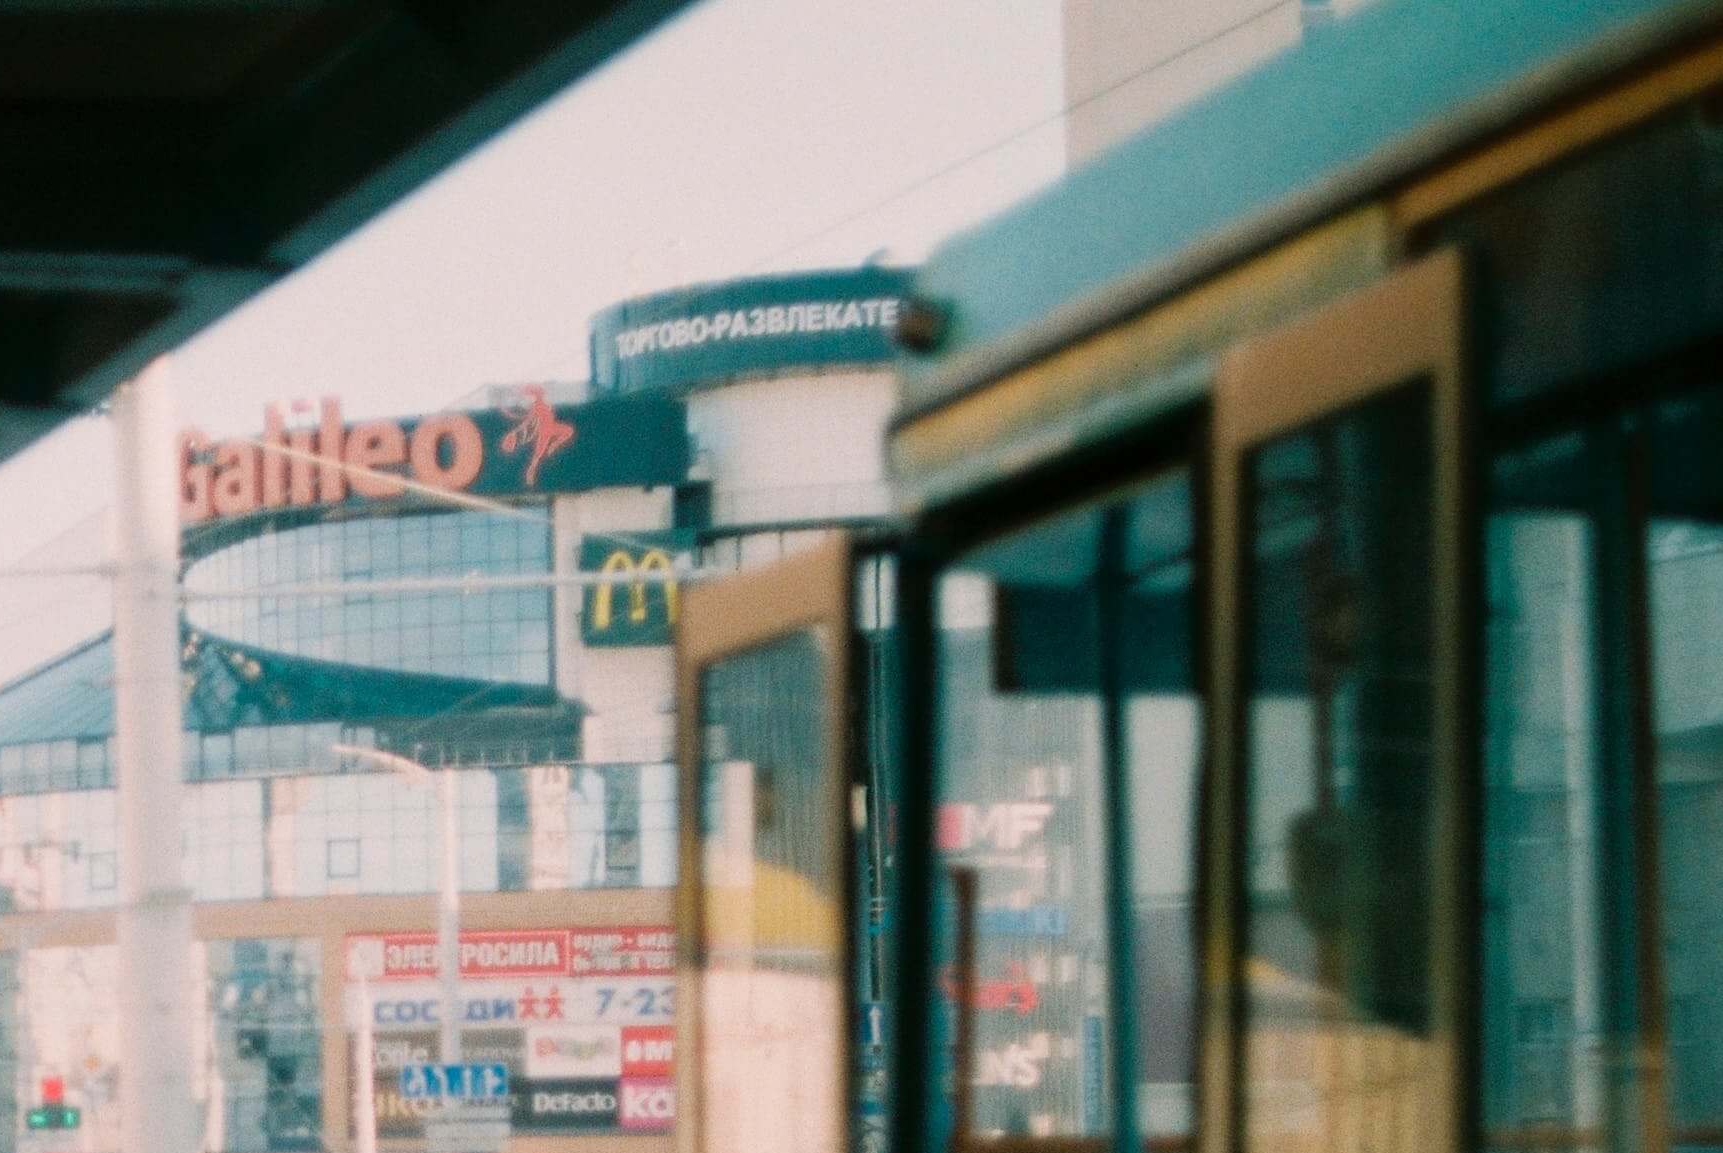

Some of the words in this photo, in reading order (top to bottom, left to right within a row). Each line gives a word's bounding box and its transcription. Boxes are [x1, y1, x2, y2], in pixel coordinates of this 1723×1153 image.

[178, 396, 483, 523] Galileo
[386, 942, 560, 970] ЭЛЕРОСИЛА
[374, 999, 515, 1023] СОСДИ
